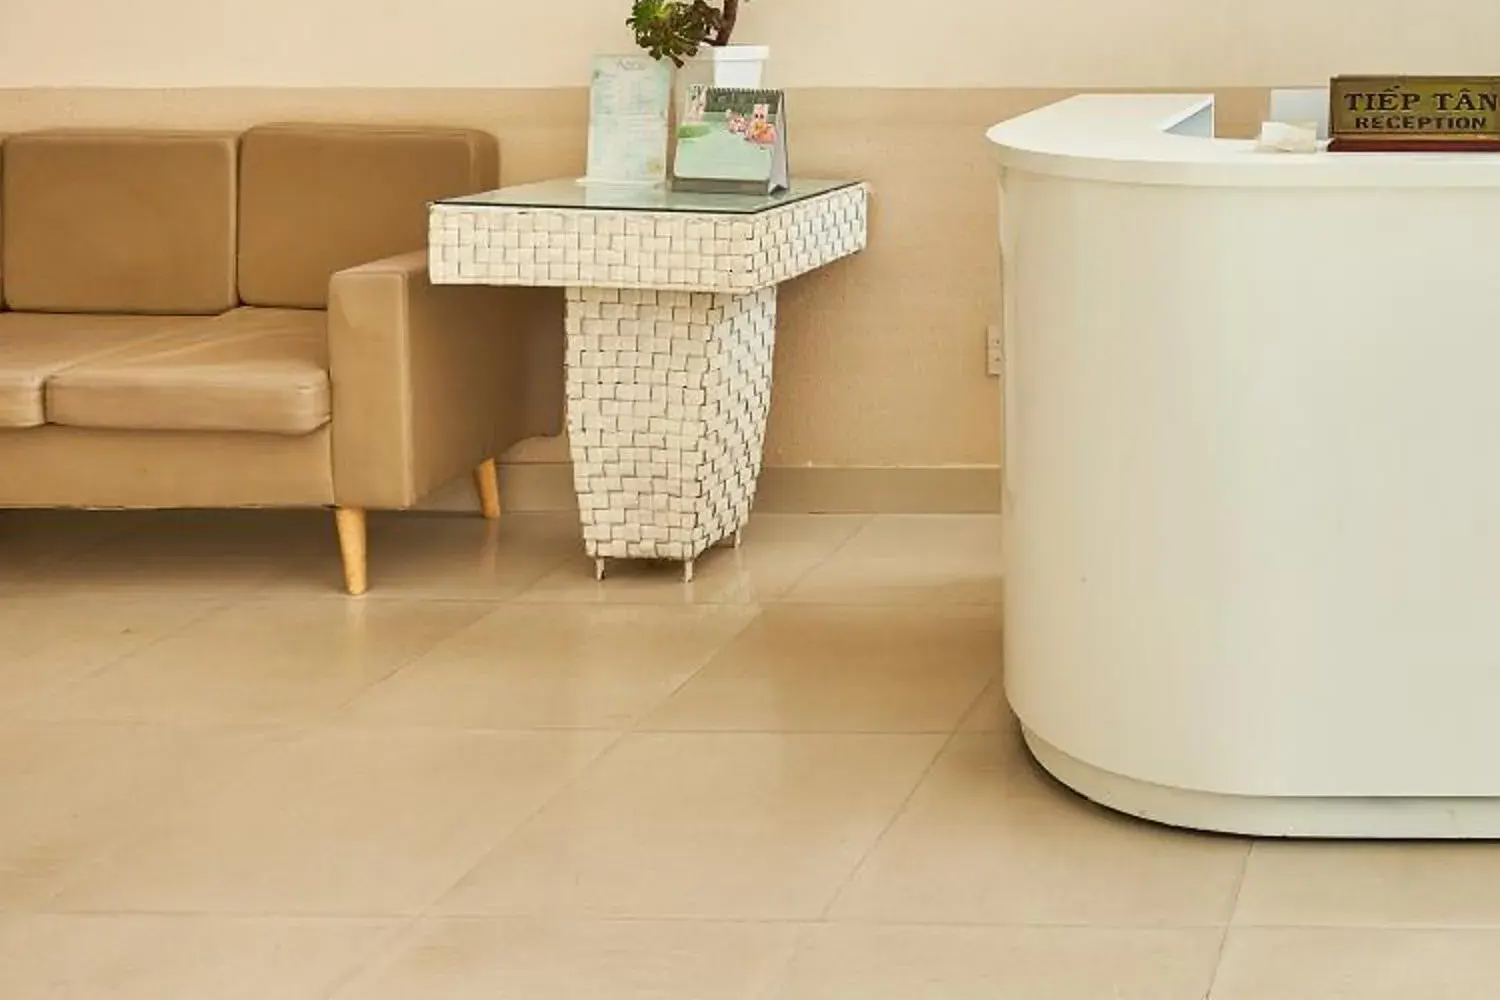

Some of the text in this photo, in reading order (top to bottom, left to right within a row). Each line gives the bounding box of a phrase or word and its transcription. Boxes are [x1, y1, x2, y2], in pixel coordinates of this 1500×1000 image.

[1344, 85, 1498, 111] TIẾP TÂN
[1355, 116, 1487, 129] RECEPTION
